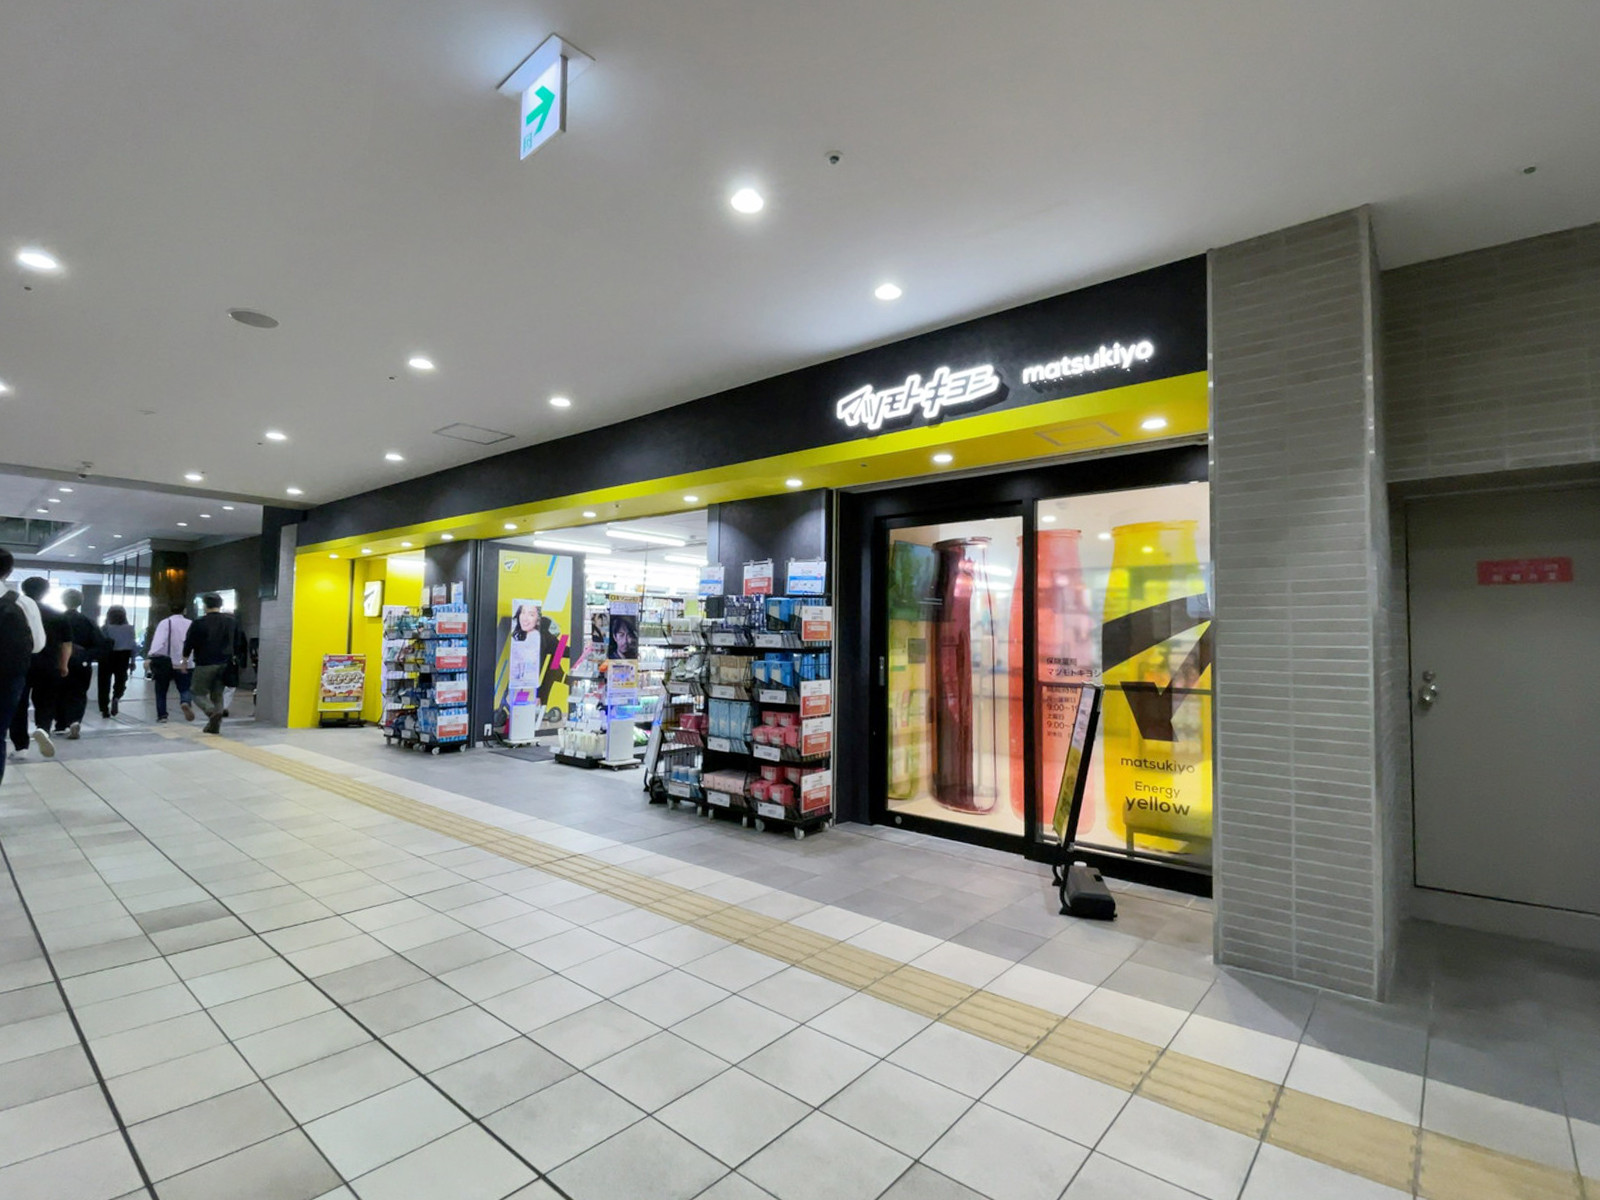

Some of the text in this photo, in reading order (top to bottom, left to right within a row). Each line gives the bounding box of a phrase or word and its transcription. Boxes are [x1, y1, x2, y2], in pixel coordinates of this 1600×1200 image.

[1022, 340, 1155, 384] matsukiyo
[1047, 668, 1102, 678] マツモトキヨシ
[1121, 757, 1195, 774] matsukiyo
[1135, 781, 1180, 799] Energy
[1125, 796, 1191, 816] yellow
